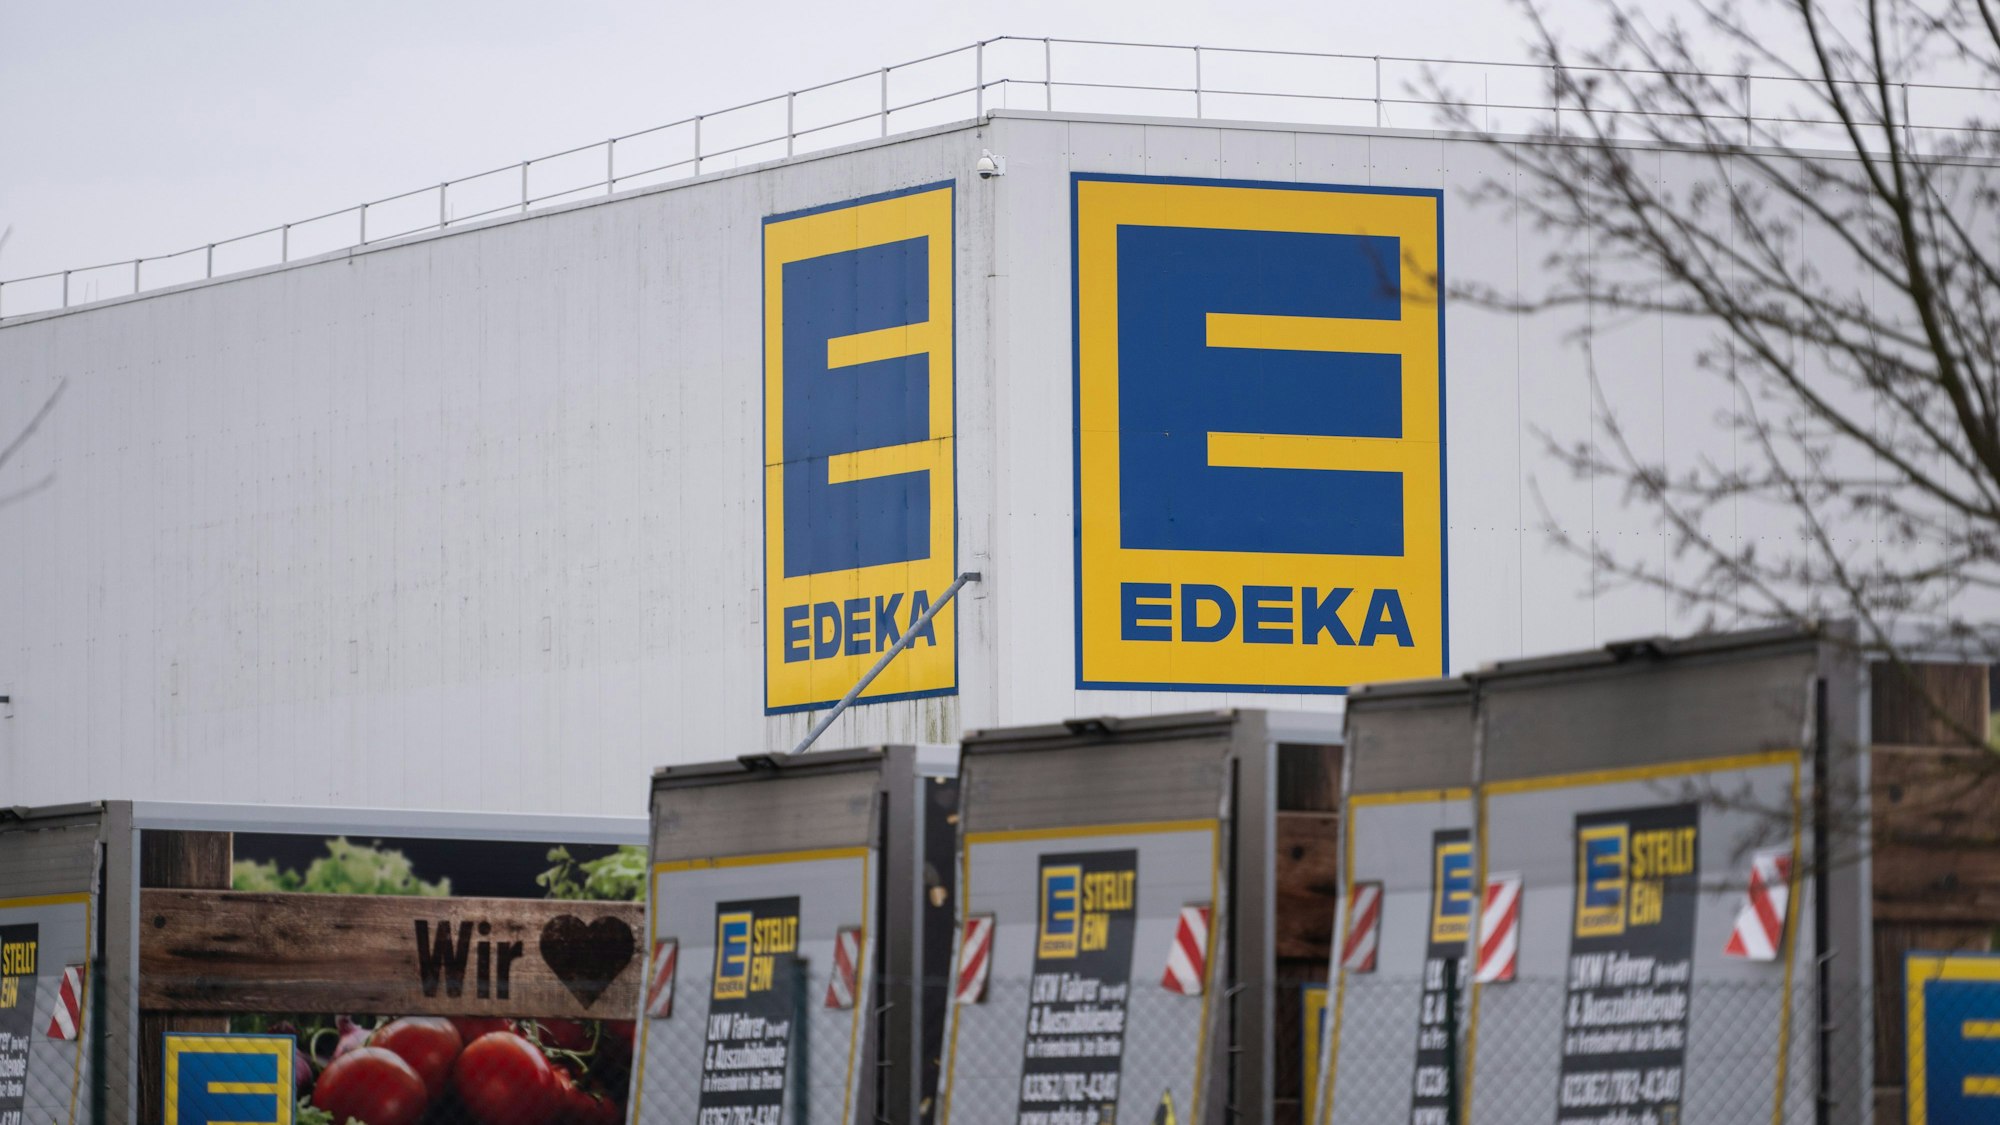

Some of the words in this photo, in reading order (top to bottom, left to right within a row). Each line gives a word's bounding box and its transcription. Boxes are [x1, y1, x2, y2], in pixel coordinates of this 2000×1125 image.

[782, 235, 930, 579] E
[1116, 224, 1405, 557] E
[783, 589, 937, 664] EDEKA
[1120, 582, 1415, 648] EDEKA
[1630, 827, 1697, 879] STELLT
[1083, 870, 1136, 911] STELLT
[1629, 879, 1664, 926] EIN
[753, 916, 798, 954] STELLT
[1081, 913, 1110, 951] EIN
[3, 941, 37, 976] STELLT
[415, 917, 524, 1000] Wir
[750, 956, 775, 992] EIN
[0, 976, 19, 1008] EIN
[708, 1013, 732, 1041] LKW
[731, 1012, 766, 1041] Fahrer
[714, 1041, 785, 1071] Auszubildende
